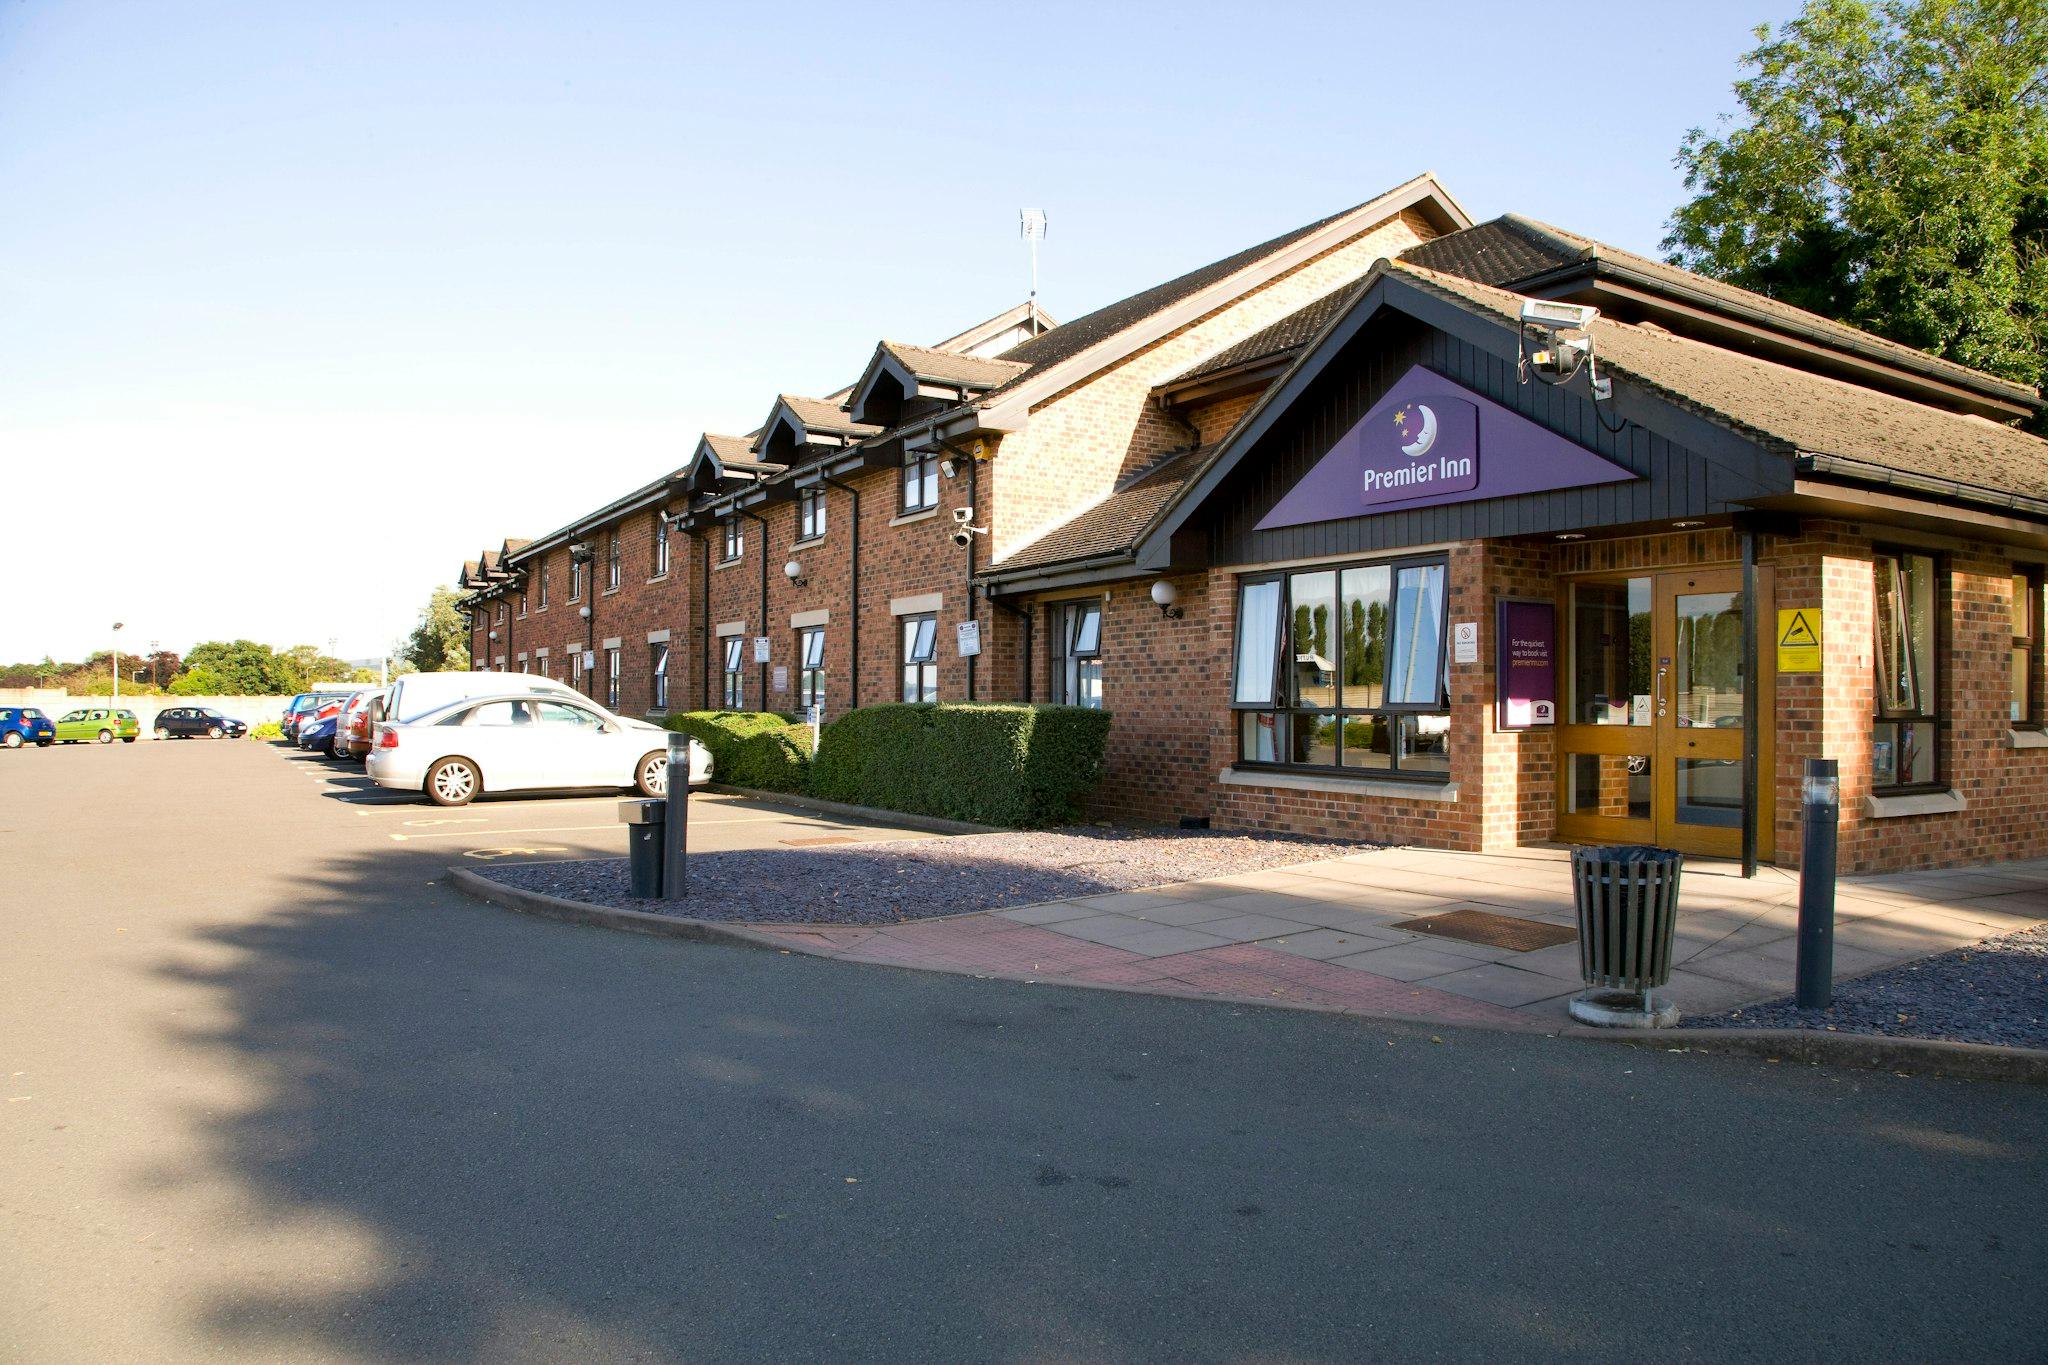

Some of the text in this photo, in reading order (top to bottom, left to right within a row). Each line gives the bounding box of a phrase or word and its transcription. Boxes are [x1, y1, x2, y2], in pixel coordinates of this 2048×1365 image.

[1364, 457, 1471, 491] Premier Inn
[1512, 639, 1520, 647] For
